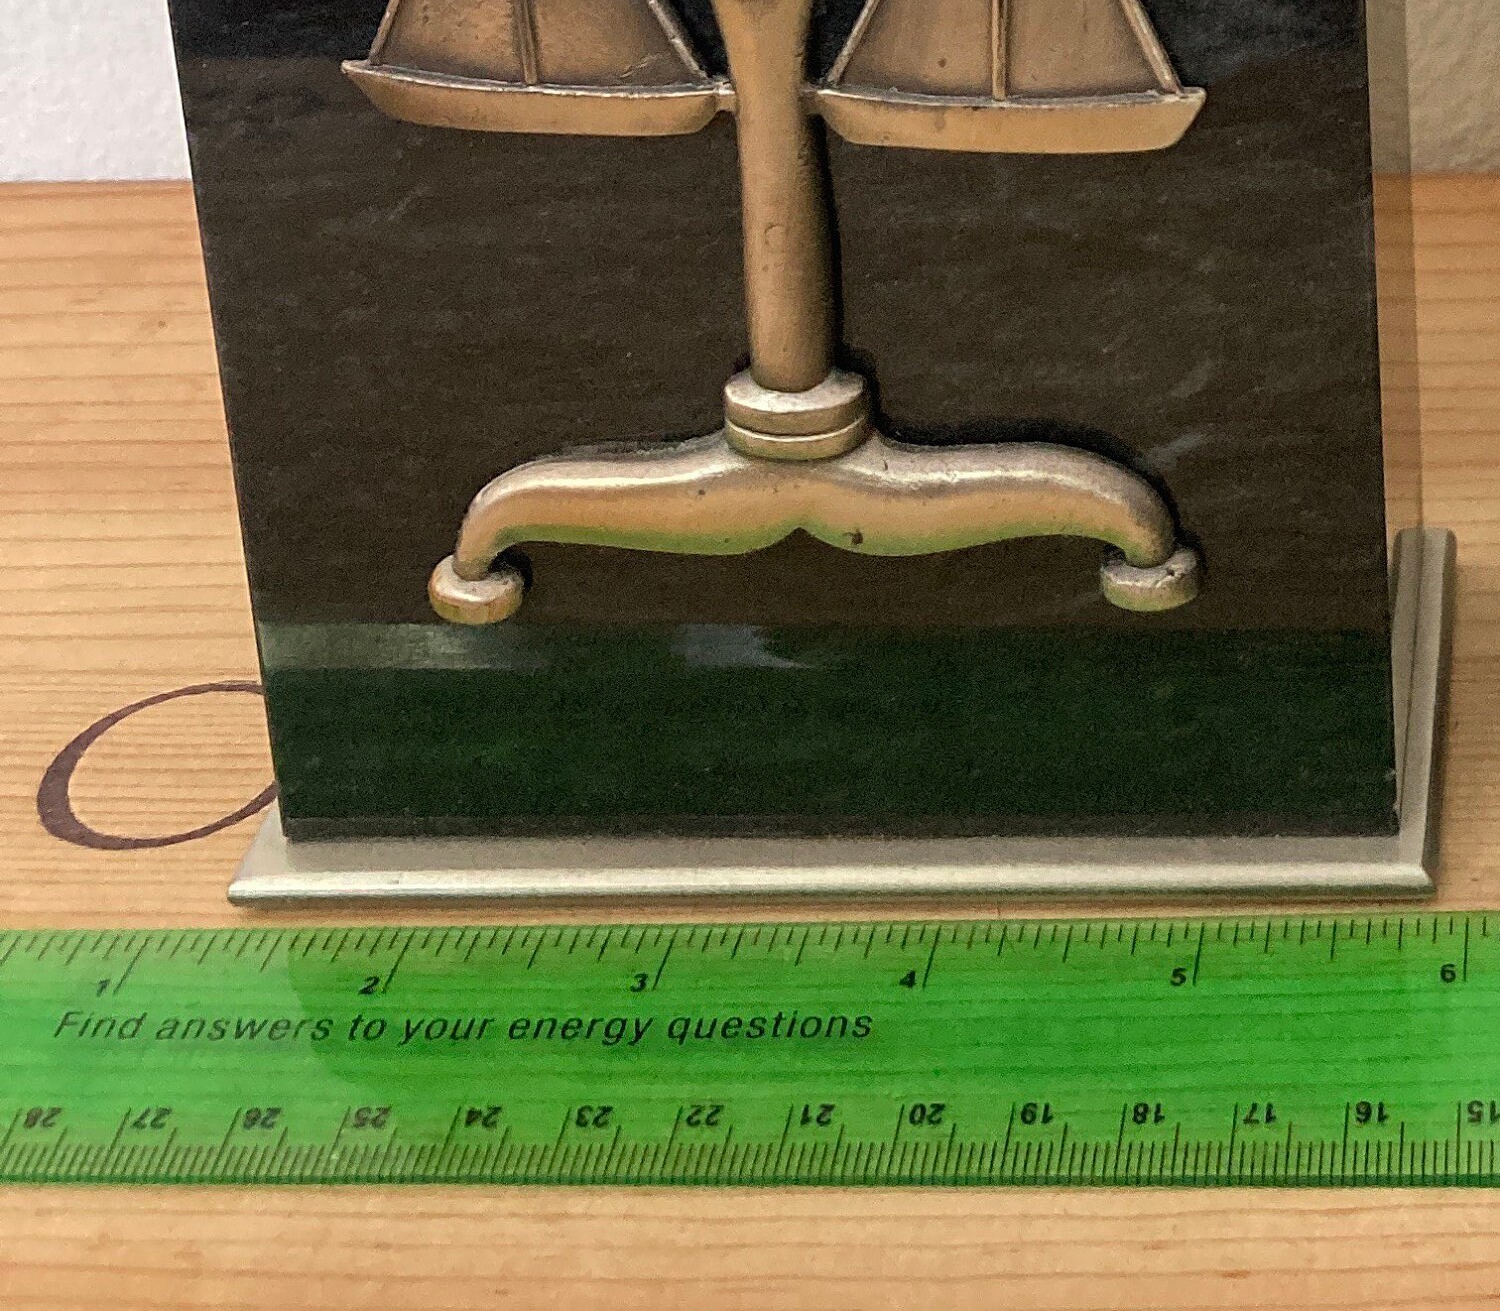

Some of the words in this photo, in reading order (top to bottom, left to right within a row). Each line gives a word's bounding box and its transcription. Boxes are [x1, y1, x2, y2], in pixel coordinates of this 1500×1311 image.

[96, 977, 110, 996] 1
[359, 976, 381, 995] 2
[630, 973, 648, 993] 3
[899, 970, 917, 989] 4
[1170, 967, 1187, 987] 5
[1440, 963, 1457, 983] 6
[53, 1010, 148, 1040] Find
[156, 1016, 334, 1041] answers
[348, 1012, 387, 1041] to
[399, 1016, 496, 1046] your
[508, 1016, 653, 1047] energy
[667, 1010, 873, 1046] questions
[24, 1107, 62, 1129] 28
[131, 1107, 172, 1130] 27
[242, 1107, 282, 1130] 26
[352, 1106, 391, 1130] 25
[465, 1105, 502, 1129] 24
[575, 1105, 614, 1129] 23
[685, 1104, 725, 1127] 22
[799, 1104, 836, 1127] 21
[908, 1103, 946, 1125] 20
[1019, 1103, 1054, 1125] 19
[1132, 1102, 1165, 1125] 18
[1243, 1102, 1276, 1124] 17
[1354, 1101, 1388, 1124] 16
[1467, 1100, 1500, 1123] 15
